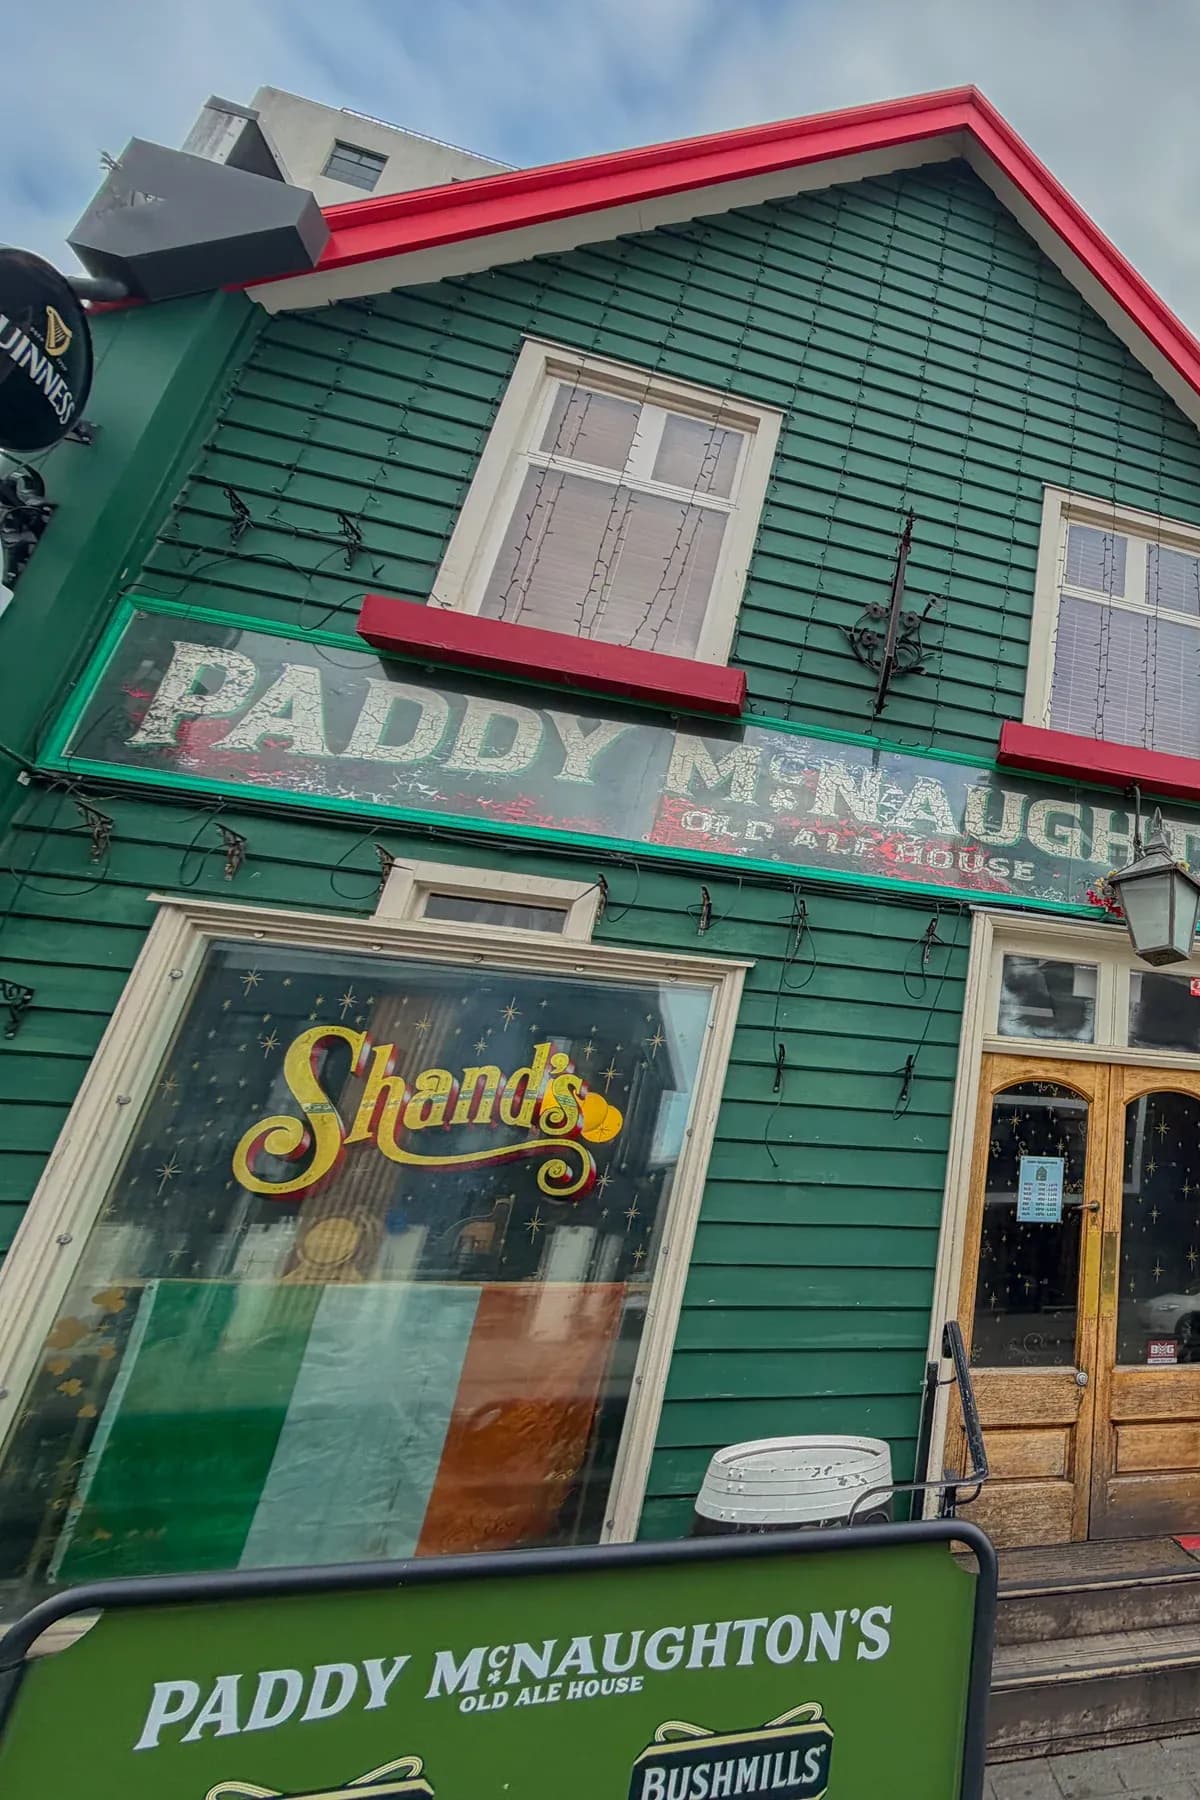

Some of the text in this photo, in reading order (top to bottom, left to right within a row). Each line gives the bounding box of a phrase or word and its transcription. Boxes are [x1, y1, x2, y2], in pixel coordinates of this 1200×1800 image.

[0, 314, 75, 425] UINNESS
[124, 640, 632, 784] PADDY
[895, 841, 1034, 882] HOUSE
[232, 1024, 598, 1198] Shand's
[133, 1655, 412, 1750] PADDY
[458, 1675, 645, 1713] OLD ALE HOUSE
[640, 1748, 822, 1800] BUSHMILLS
